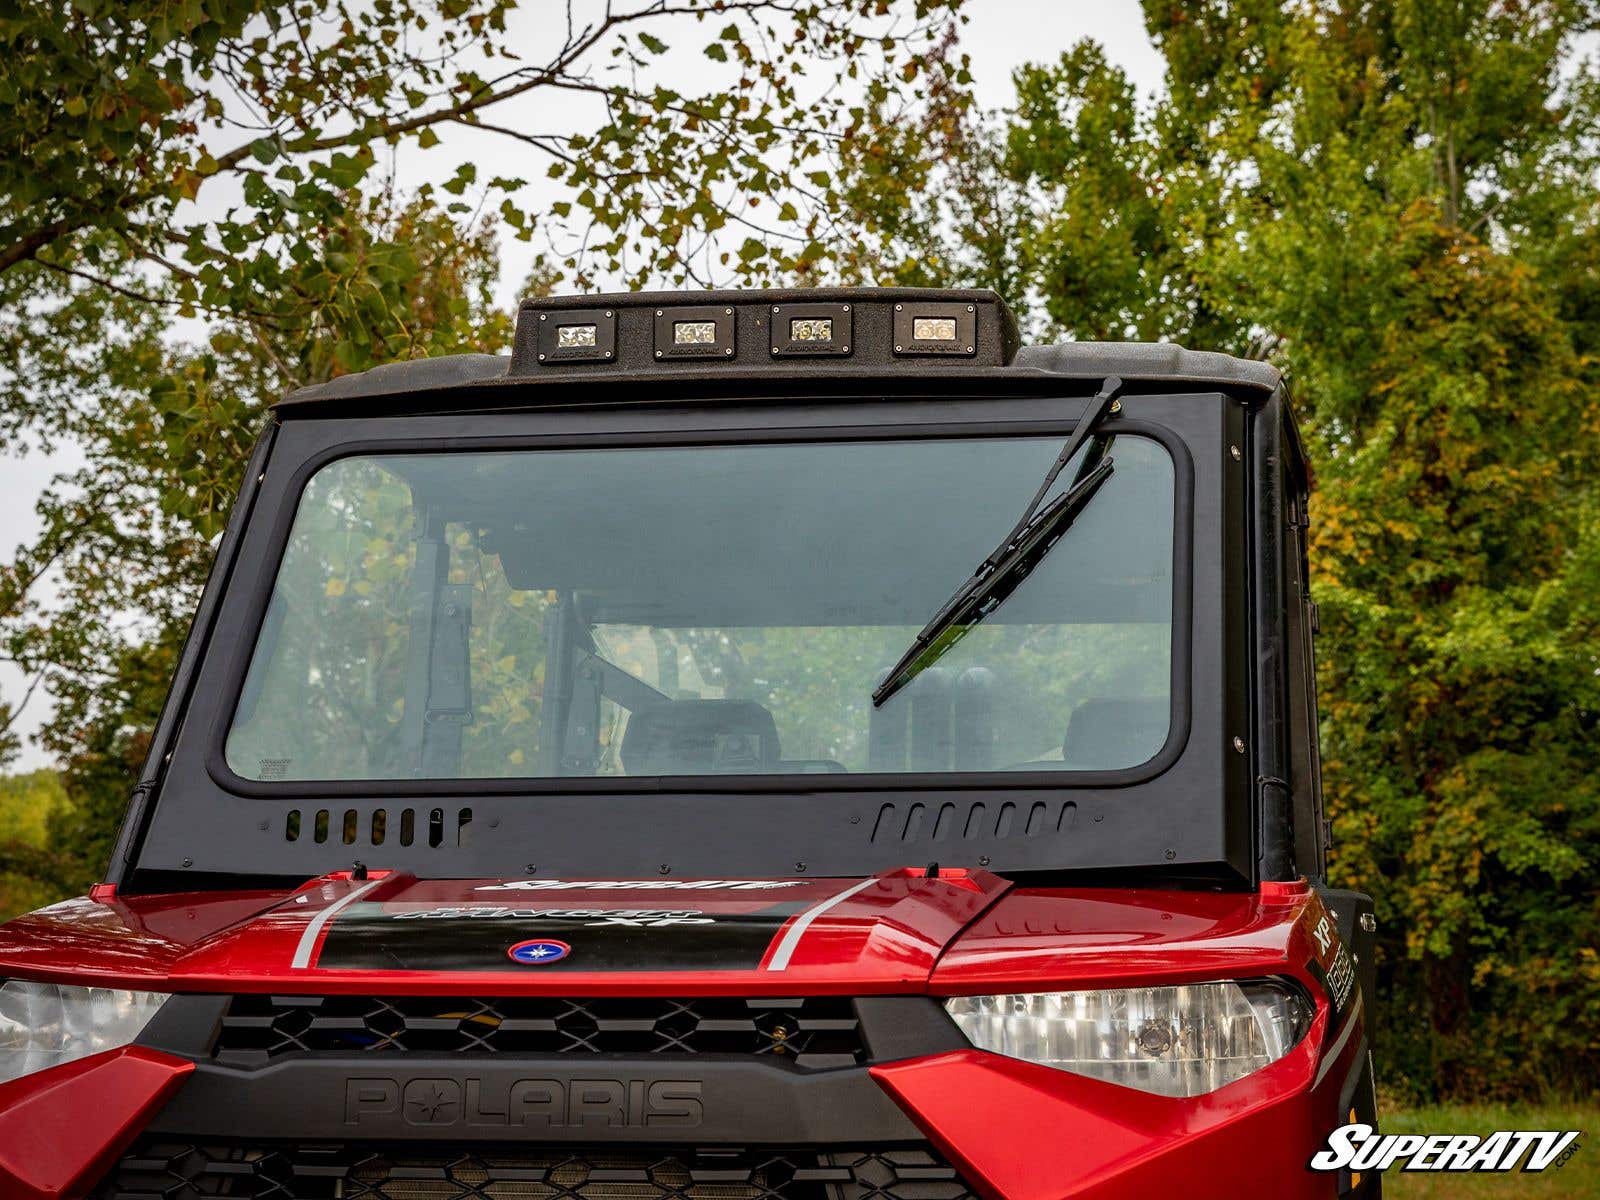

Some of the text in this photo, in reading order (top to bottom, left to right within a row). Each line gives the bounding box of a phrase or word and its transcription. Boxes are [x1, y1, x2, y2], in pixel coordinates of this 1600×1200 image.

[584, 917, 716, 927] XP
[1313, 916, 1332, 956] XP
[344, 1077, 704, 1128] POLARIS
